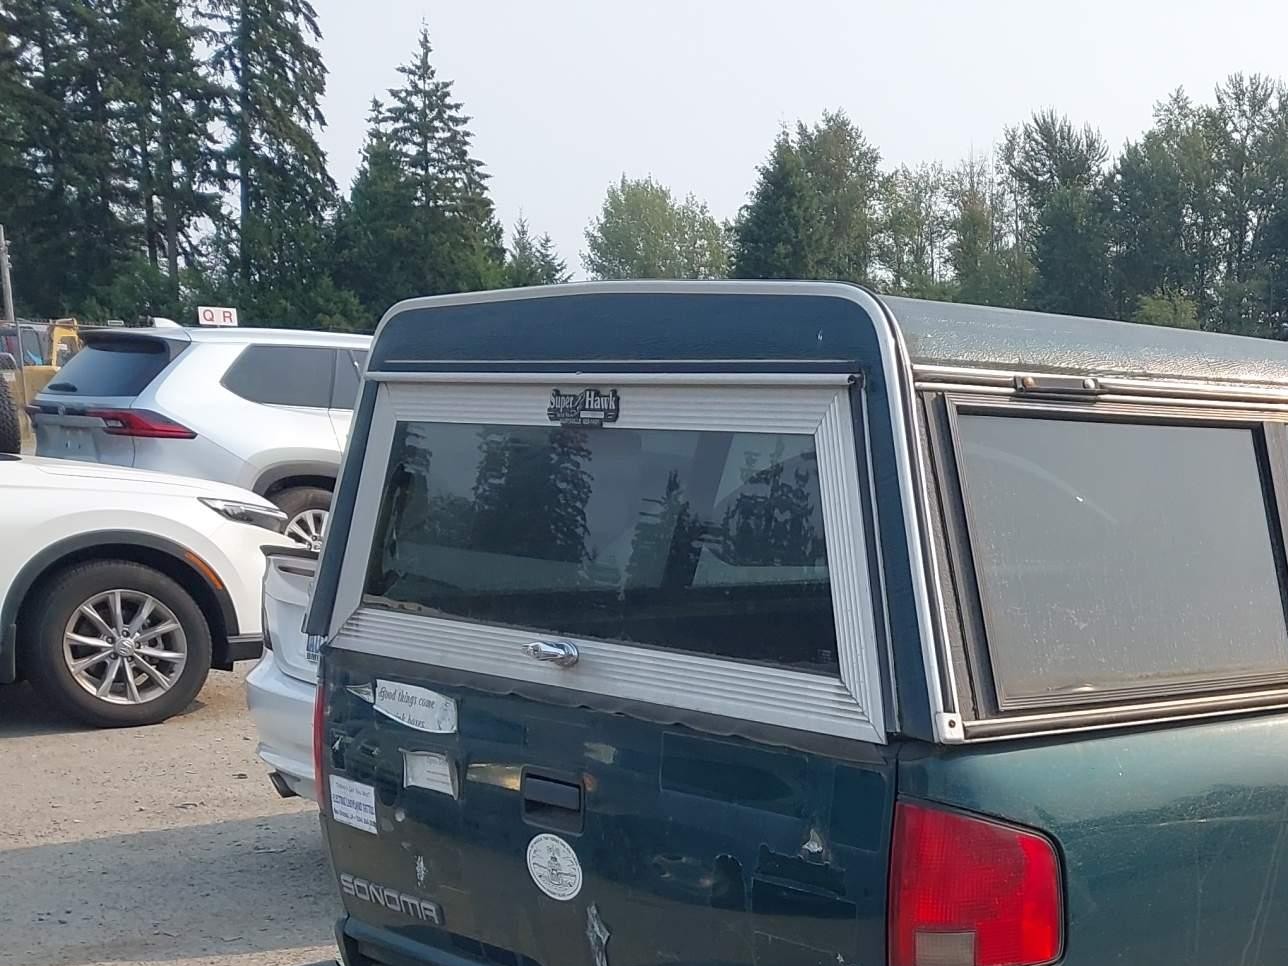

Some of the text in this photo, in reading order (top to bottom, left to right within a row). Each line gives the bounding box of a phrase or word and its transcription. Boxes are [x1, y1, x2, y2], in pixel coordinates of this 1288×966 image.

[203, 309, 232, 323] Q R
[550, 390, 616, 413] Super Hawk
[379, 686, 436, 710] Good things come
[340, 873, 440, 925] SONOMA
